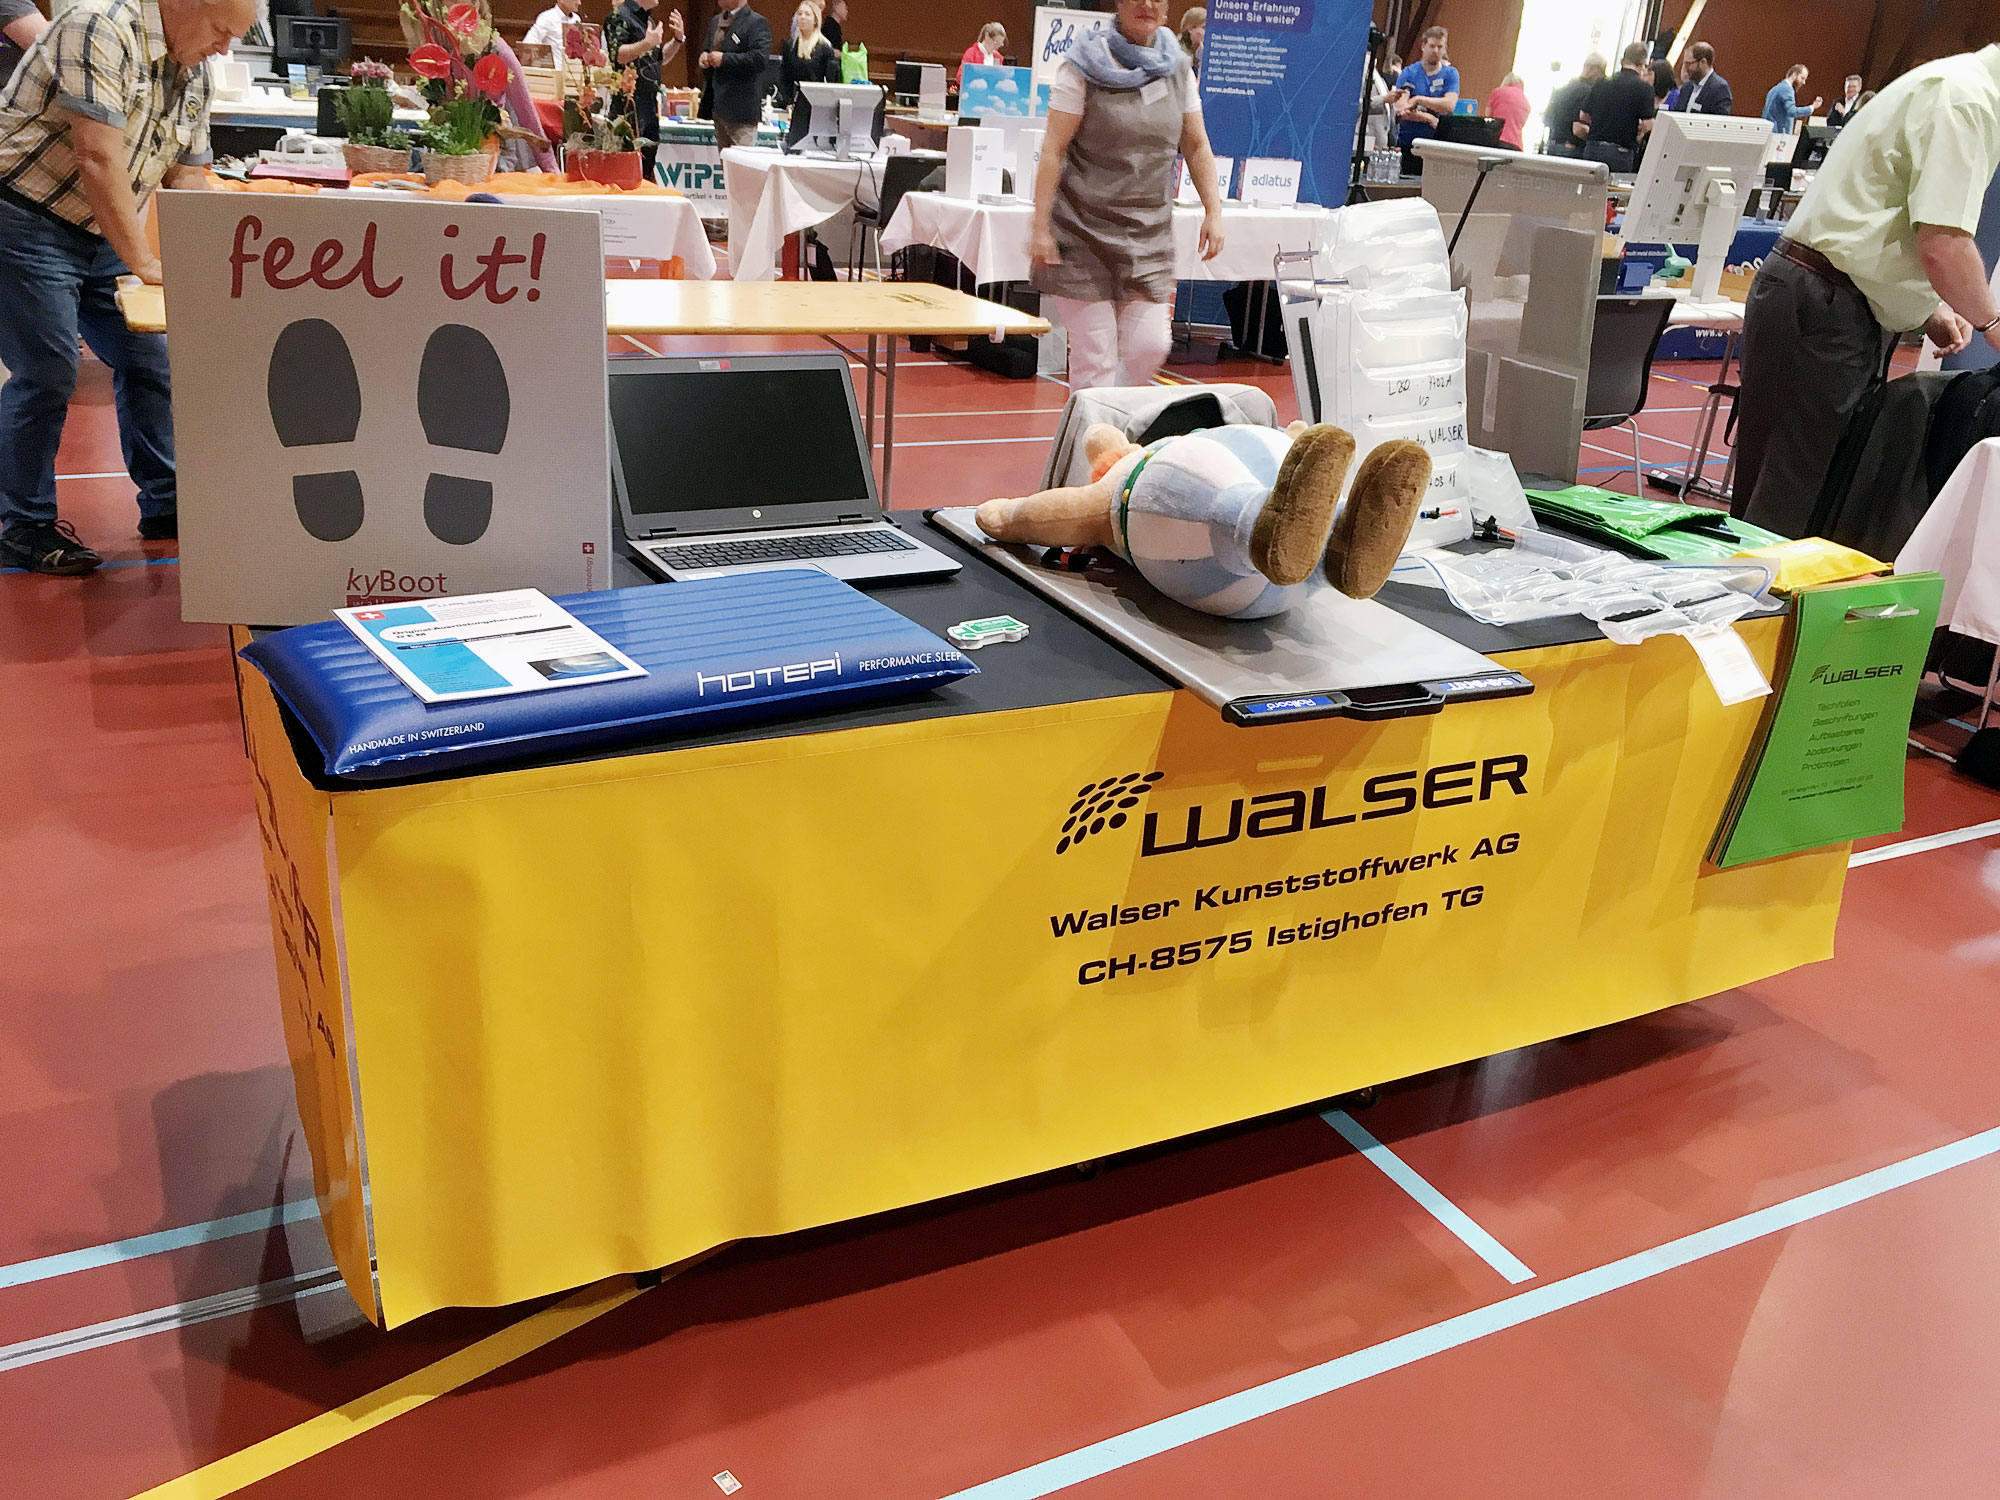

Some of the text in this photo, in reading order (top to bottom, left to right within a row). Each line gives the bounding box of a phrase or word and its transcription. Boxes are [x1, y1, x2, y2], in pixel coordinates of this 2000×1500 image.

[1214, 10, 1295, 25] bringt Sie weiter
[1215, 0, 1301, 16] Unsere Erfahrung
[1252, 174, 1292, 187] adlatus
[229, 214, 404, 299] feel
[440, 224, 547, 305] it!
[347, 568, 448, 598] kyBoot
[348, 722, 485, 755] HANDMADE IN SWITZERLAND
[1050, 832, 1520, 938] Walser Kunststoffwerk AG
[1078, 885, 1485, 985] CH-8575 Istighofen TG
